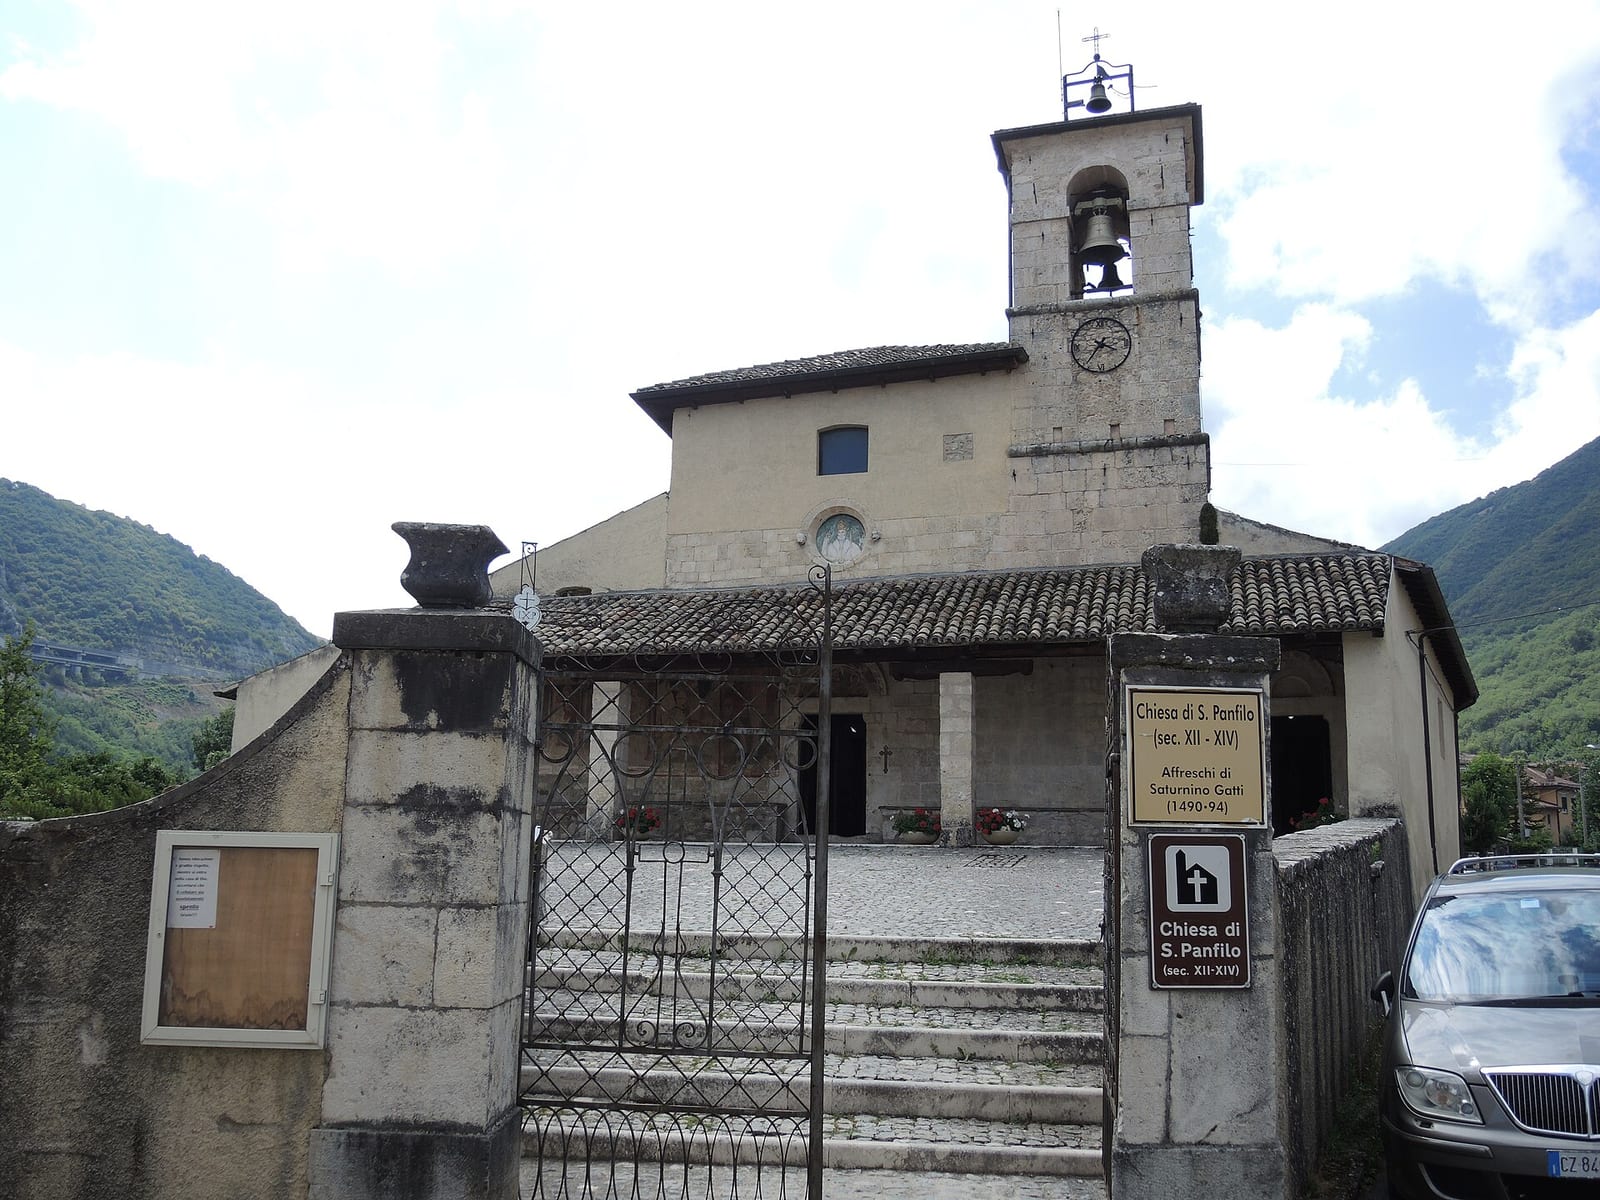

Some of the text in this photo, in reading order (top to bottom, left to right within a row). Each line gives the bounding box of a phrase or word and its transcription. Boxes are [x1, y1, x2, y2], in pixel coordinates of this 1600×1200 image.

[1136, 702, 1255, 722] Chiesa di S. Panfilo
[1153, 728, 1181, 750] (sec.
[1184, 729, 1201, 746] XII
[1214, 729, 1239, 751] XIV)
[1161, 766, 1231, 779] Affreschi di
[1149, 783, 1244, 796] Saturnino Gatti
[1159, 921, 1240, 937] Chiesa di
[1160, 942, 1241, 958] S. Panfilo
[1163, 964, 1240, 977] (sec. XII-XIV)
[1560, 1157, 1577, 1173] CZ
